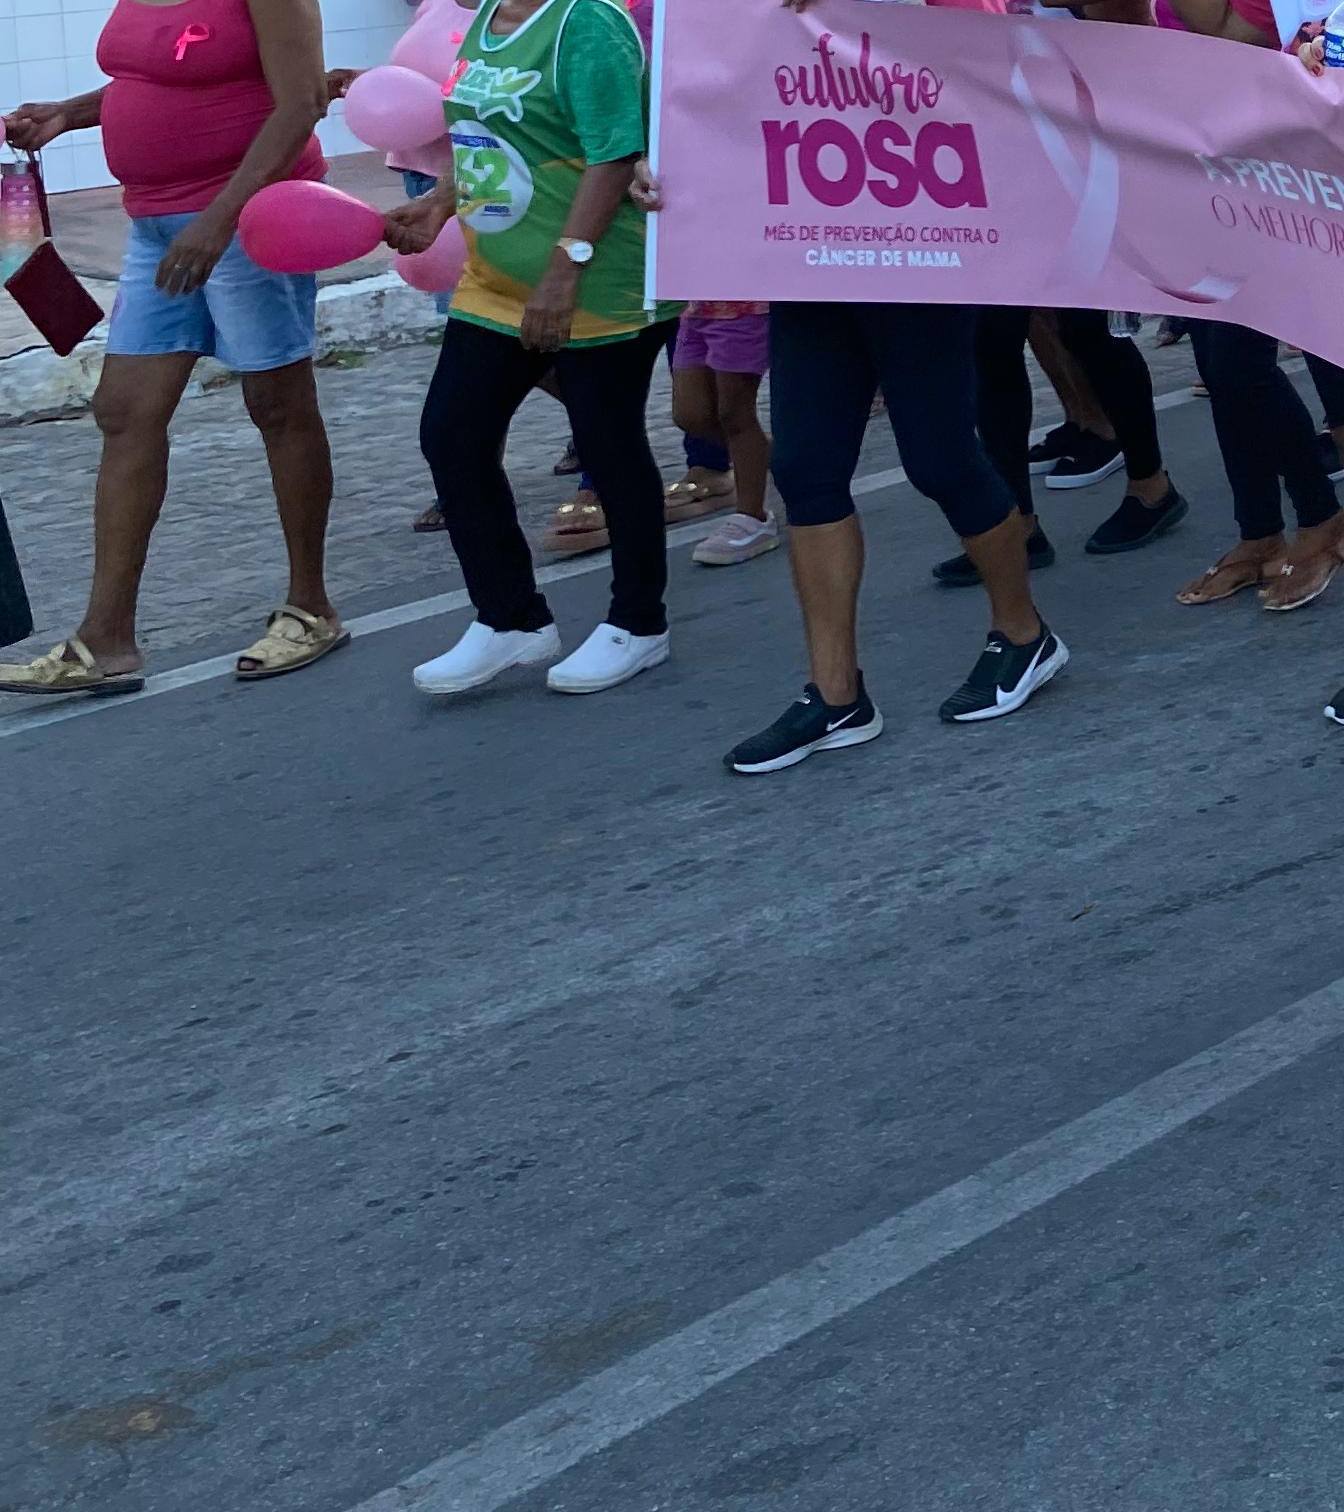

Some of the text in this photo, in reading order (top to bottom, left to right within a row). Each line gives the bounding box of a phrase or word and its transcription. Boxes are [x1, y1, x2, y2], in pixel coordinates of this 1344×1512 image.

[774, 31, 944, 116] outubro
[760, 118, 989, 209] rosa
[1211, 193, 1237, 229] O
[763, 221, 1000, 246] MÊS DE PREVENÇÃO CONTRA O
[805, 245, 962, 267] CÂNCER DE MAMA
